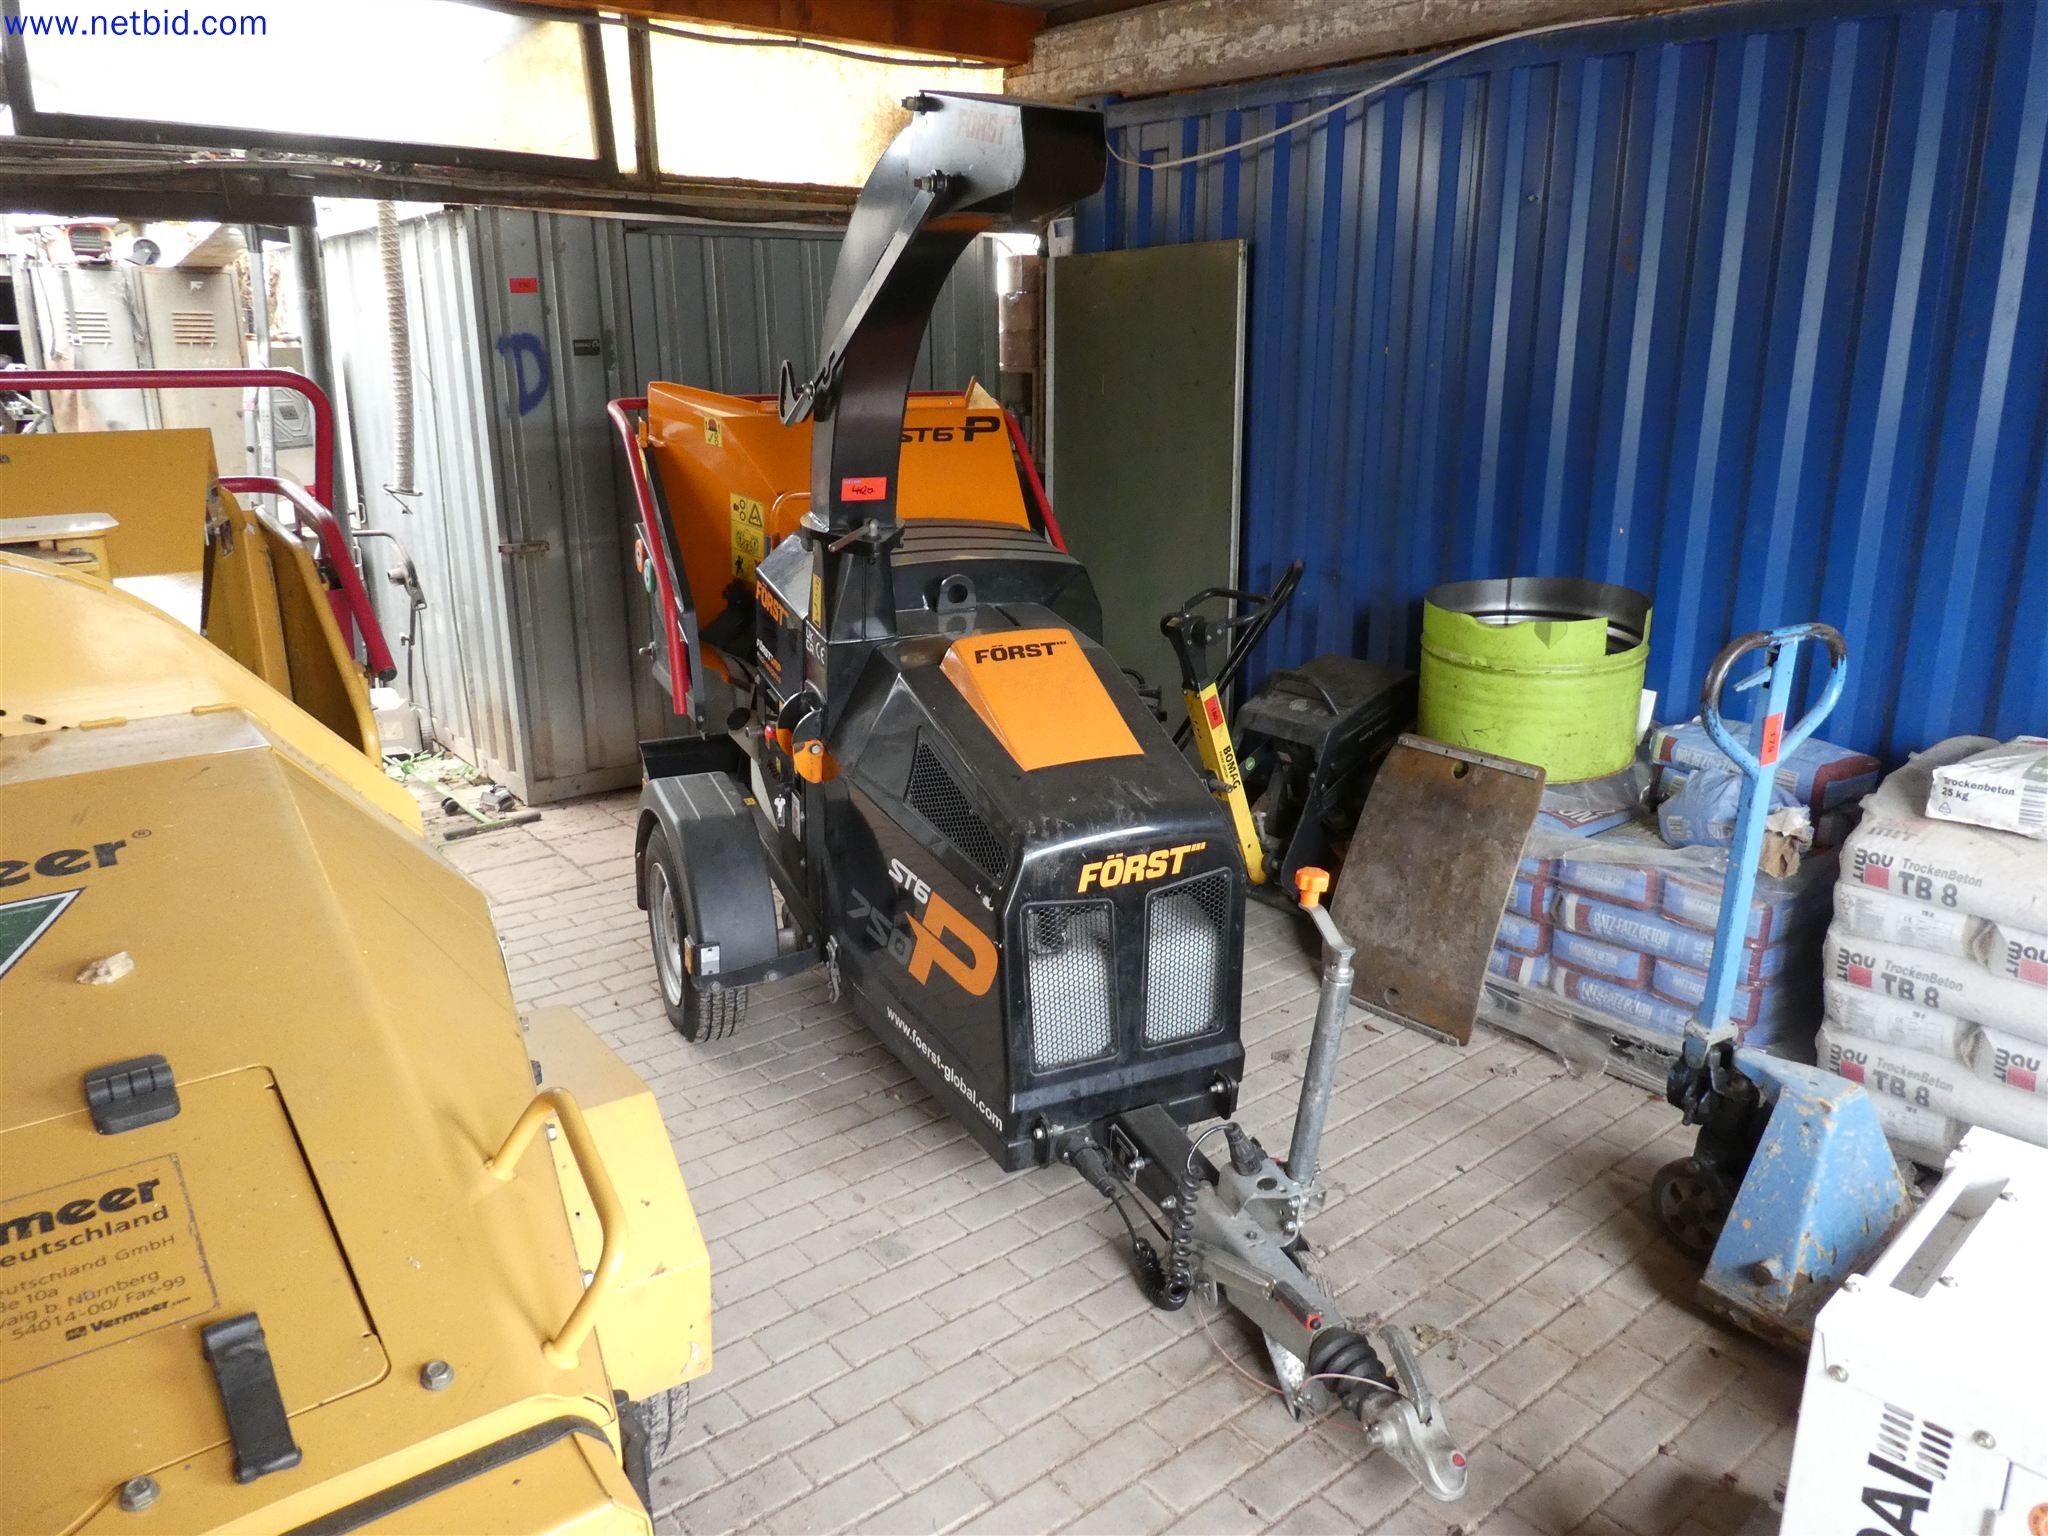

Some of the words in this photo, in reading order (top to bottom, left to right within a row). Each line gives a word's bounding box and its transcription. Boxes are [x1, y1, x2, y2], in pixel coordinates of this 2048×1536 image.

[496, 332, 551, 417] D
[975, 642, 1058, 664] FÖRST
[1943, 776, 2016, 797] Trockenbeton
[888, 858, 931, 904] ST6
[1077, 844, 1193, 894] FÖRST
[1898, 871, 1933, 901] TB
[1941, 884, 1958, 908] 8
[1881, 973, 1914, 1001] TB
[1923, 987, 1939, 1009] 8
[886, 1005, 1003, 1132] www.foerst-global.com
[1872, 1070, 1906, 1099] TB
[1914, 1086, 1930, 1108] 8
[115, 1233, 176, 1262] GmbH
[126, 1274, 187, 1304] Fax-99
